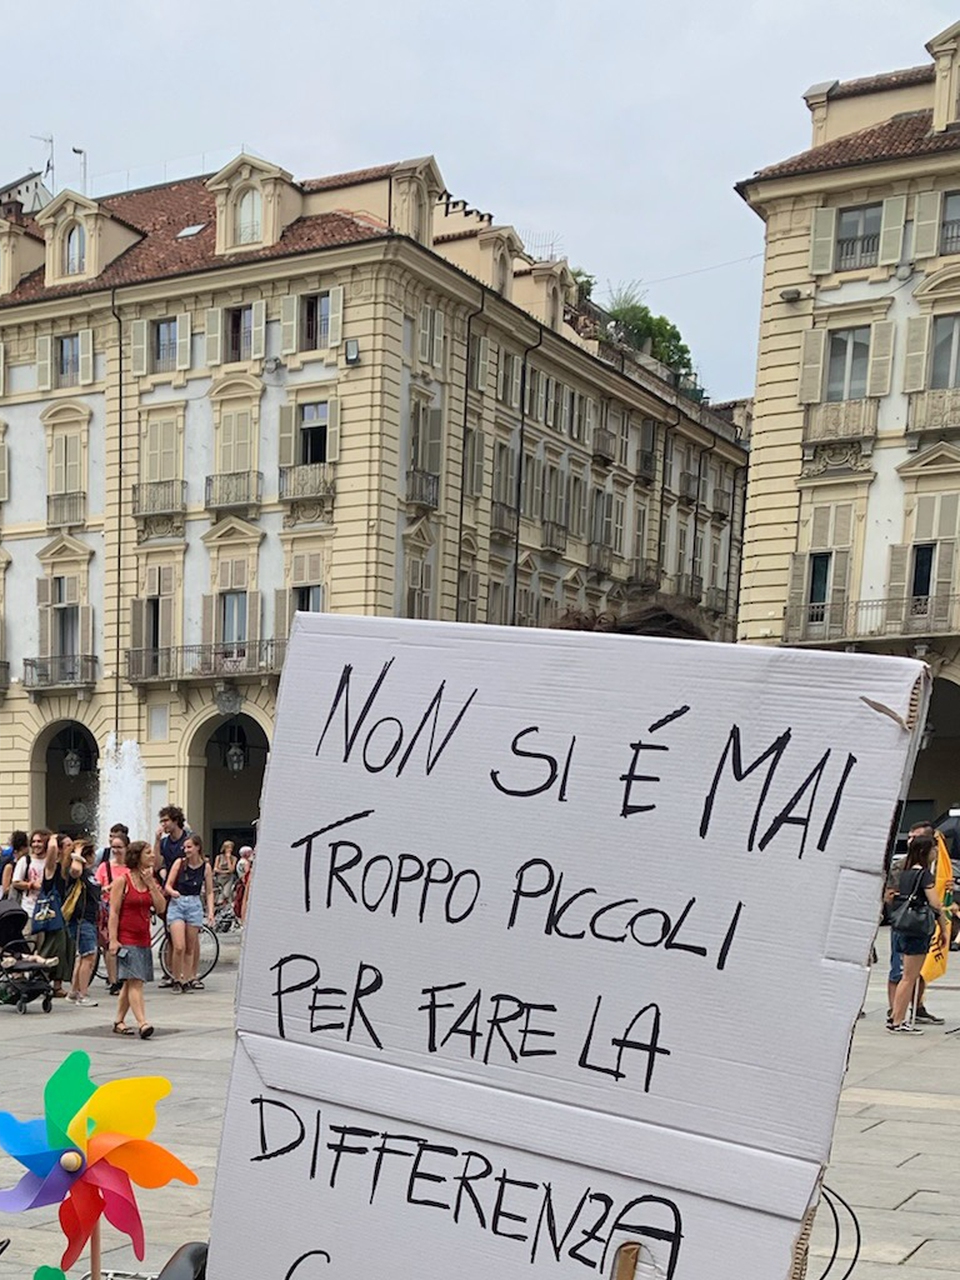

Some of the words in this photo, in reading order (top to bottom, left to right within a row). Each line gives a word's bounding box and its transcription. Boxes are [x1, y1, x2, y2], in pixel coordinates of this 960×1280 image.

[315, 657, 478, 776] NON
[491, 726, 576, 802] SI
[619, 705, 691, 818] É
[699, 725, 858, 860] MAI
[291, 810, 481, 924] TROPPO
[507, 857, 745, 971] PICCOLI
[270, 954, 384, 1051] PER
[417, 982, 558, 1064] FARE
[577, 995, 671, 1093] LA
